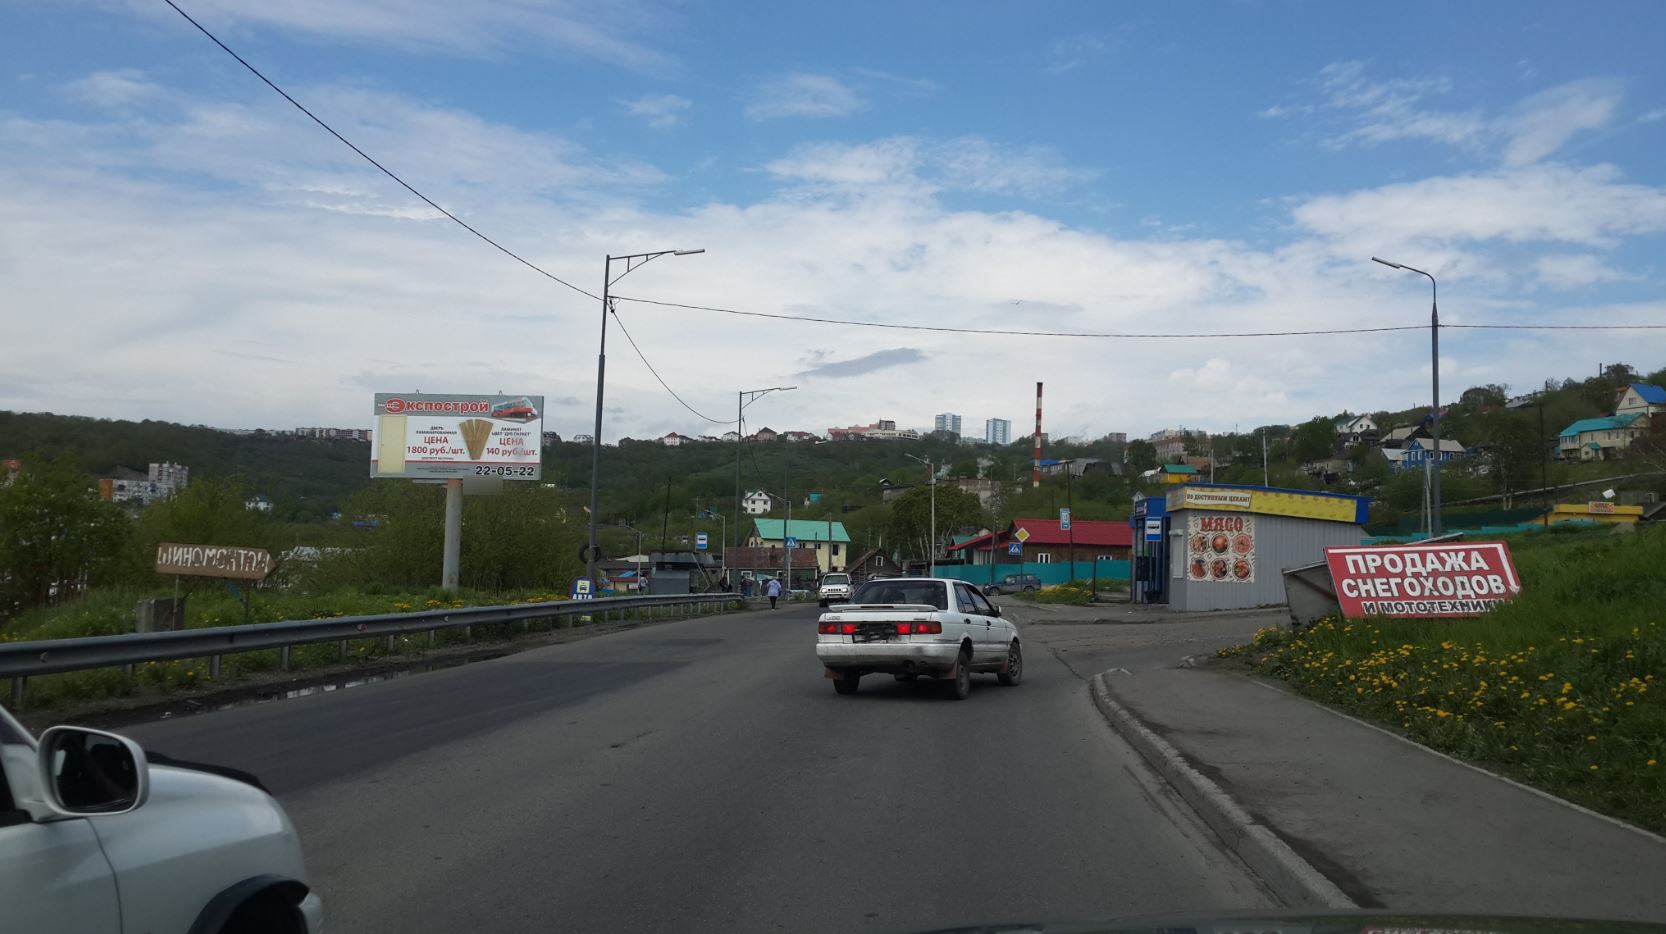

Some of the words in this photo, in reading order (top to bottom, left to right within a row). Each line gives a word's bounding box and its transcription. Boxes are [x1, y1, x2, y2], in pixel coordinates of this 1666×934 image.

[385, 398, 489, 415] Экспострой
[424, 437, 449, 445] ЦЕНА
[499, 438, 524, 446] ЦЕНА
[407, 446, 428, 454] 1800
[429, 446, 465, 455] руб./шт.
[486, 447, 500, 455] 140
[475, 465, 535, 476] 22-05-22
[1200, 516, 1244, 532] МЯСО
[1345, 551, 1490, 576] ПРОДАЖА
[1341, 574, 1507, 599] СНЕГОХОДОВ
[1362, 602, 1377, 614] И
[1379, 599, 1505, 614] МОТОТЕХНИК
